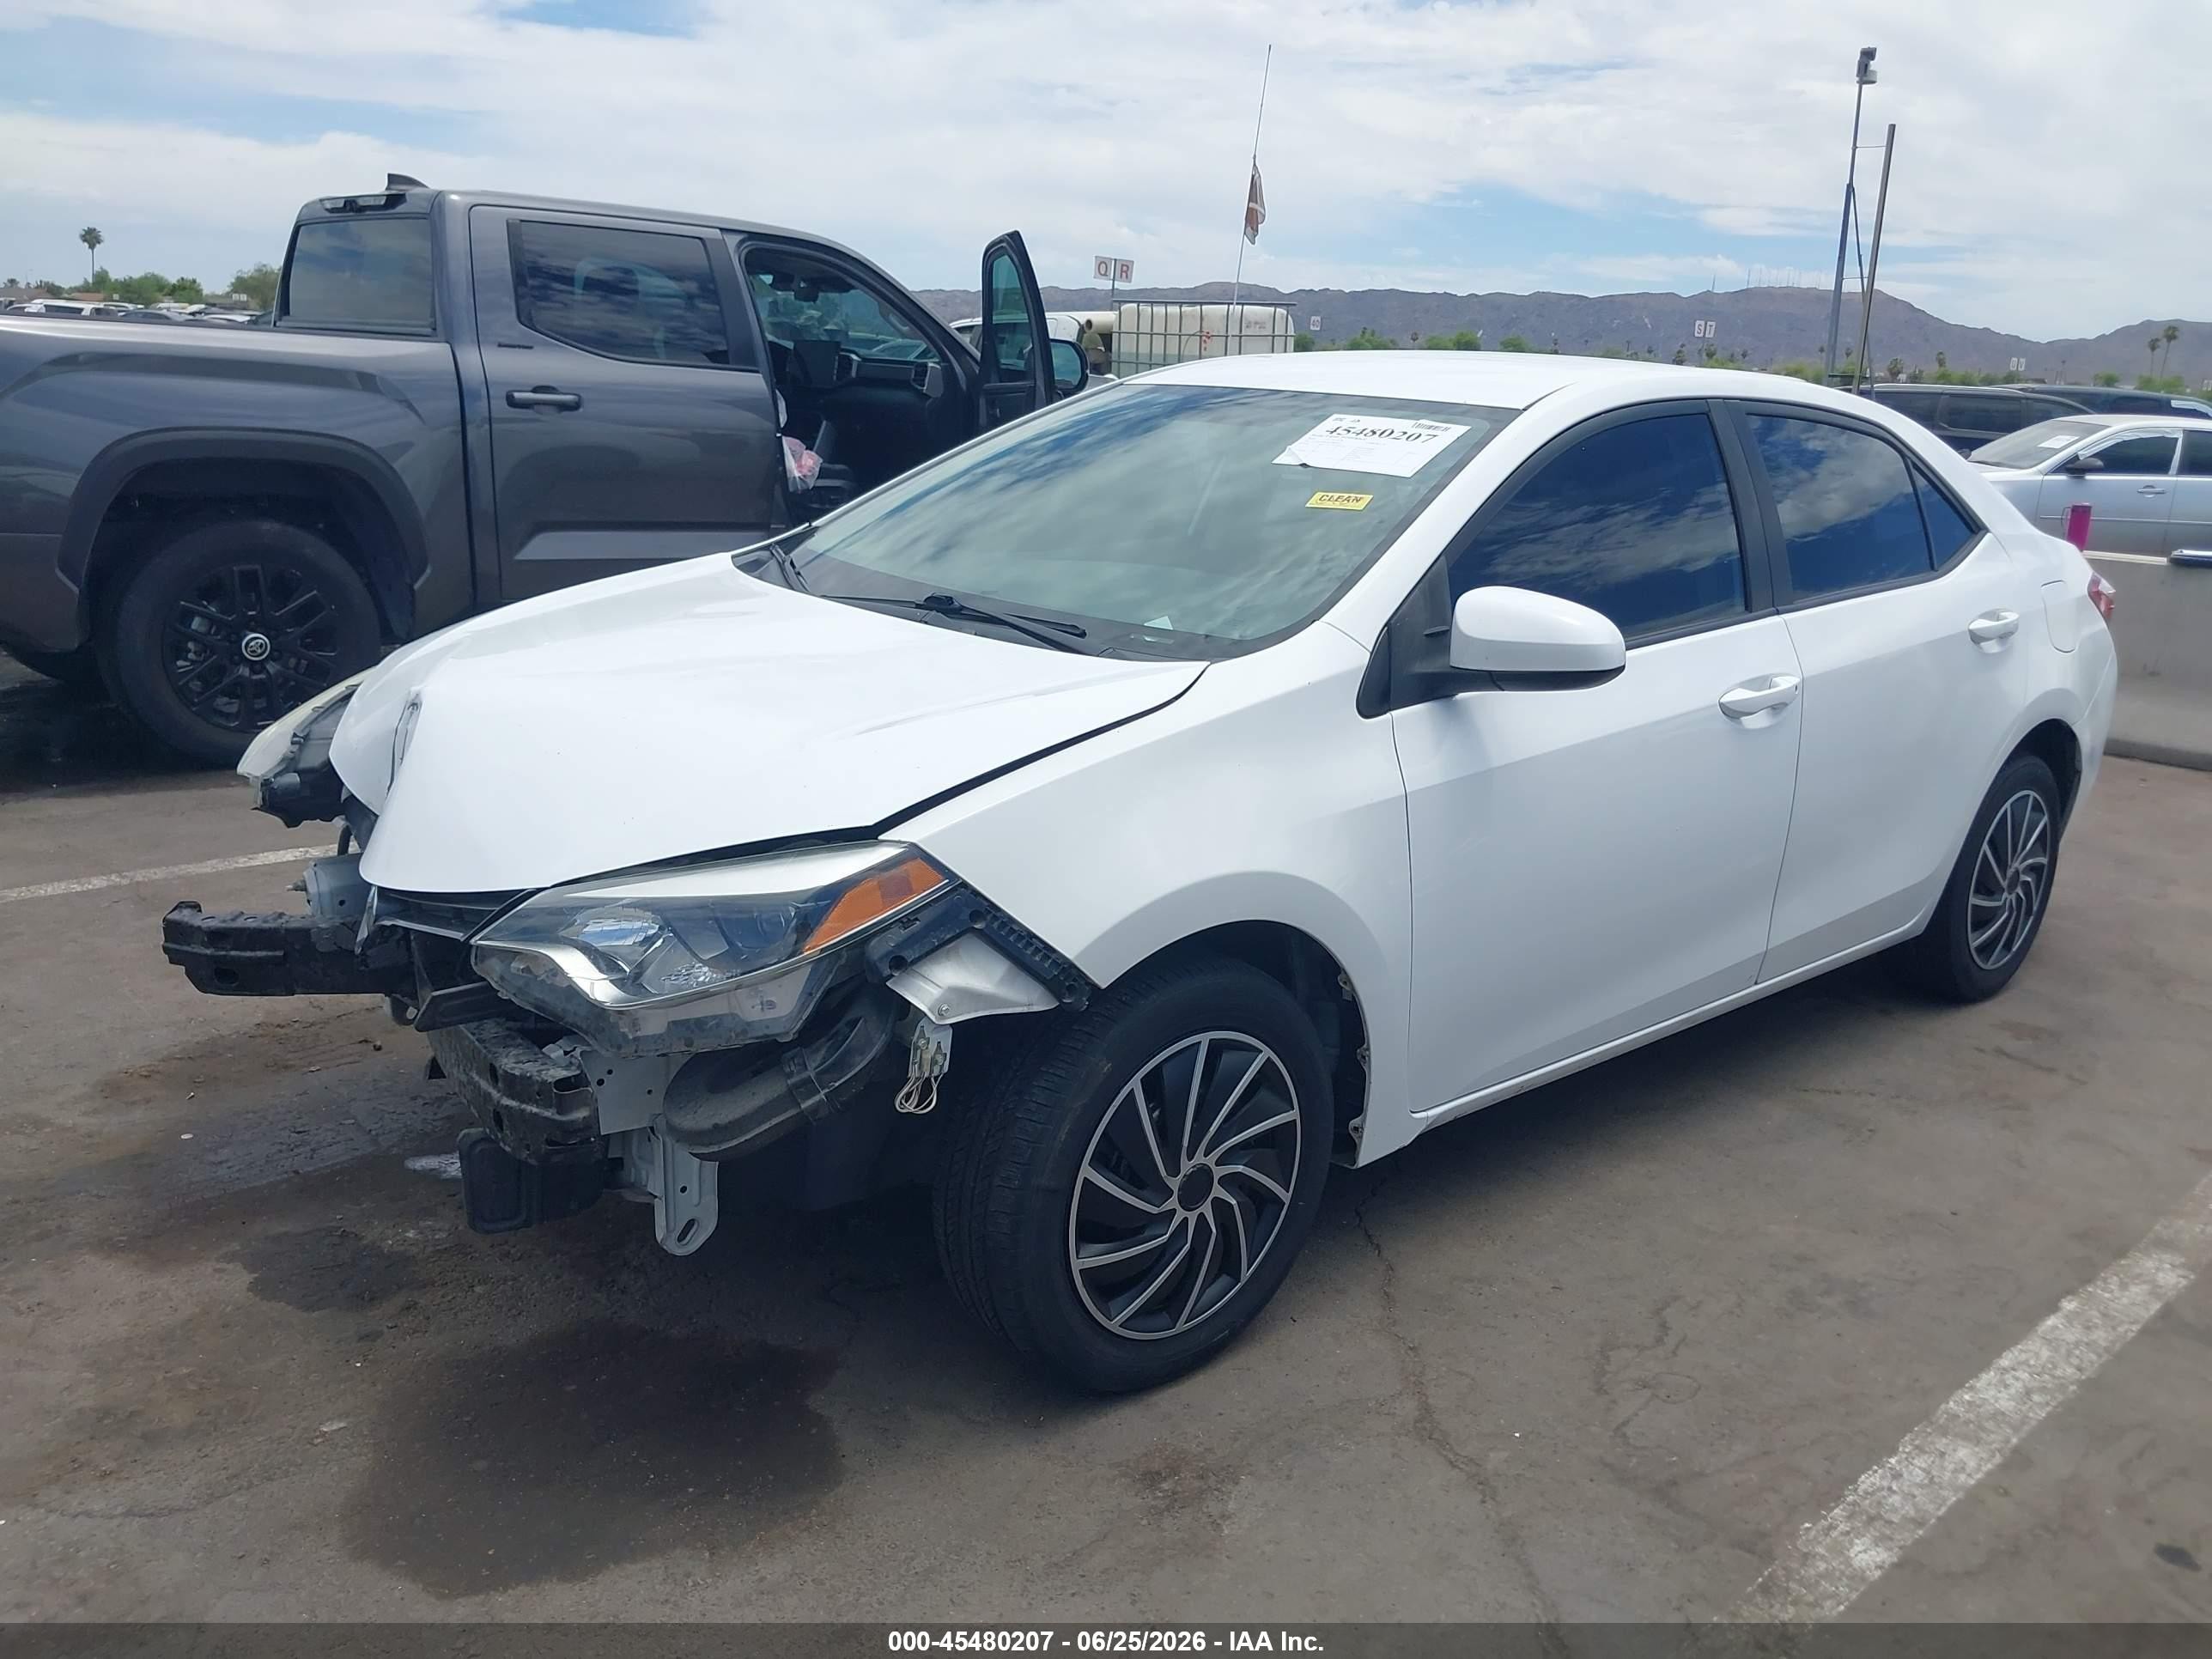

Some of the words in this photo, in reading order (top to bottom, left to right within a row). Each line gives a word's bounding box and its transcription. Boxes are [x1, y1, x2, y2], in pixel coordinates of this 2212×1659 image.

[1097, 260, 1109, 276] Q
[1120, 263, 1130, 279] R
[1325, 426, 1440, 443] 45480207
[1318, 494, 1364, 503] CLEAN
